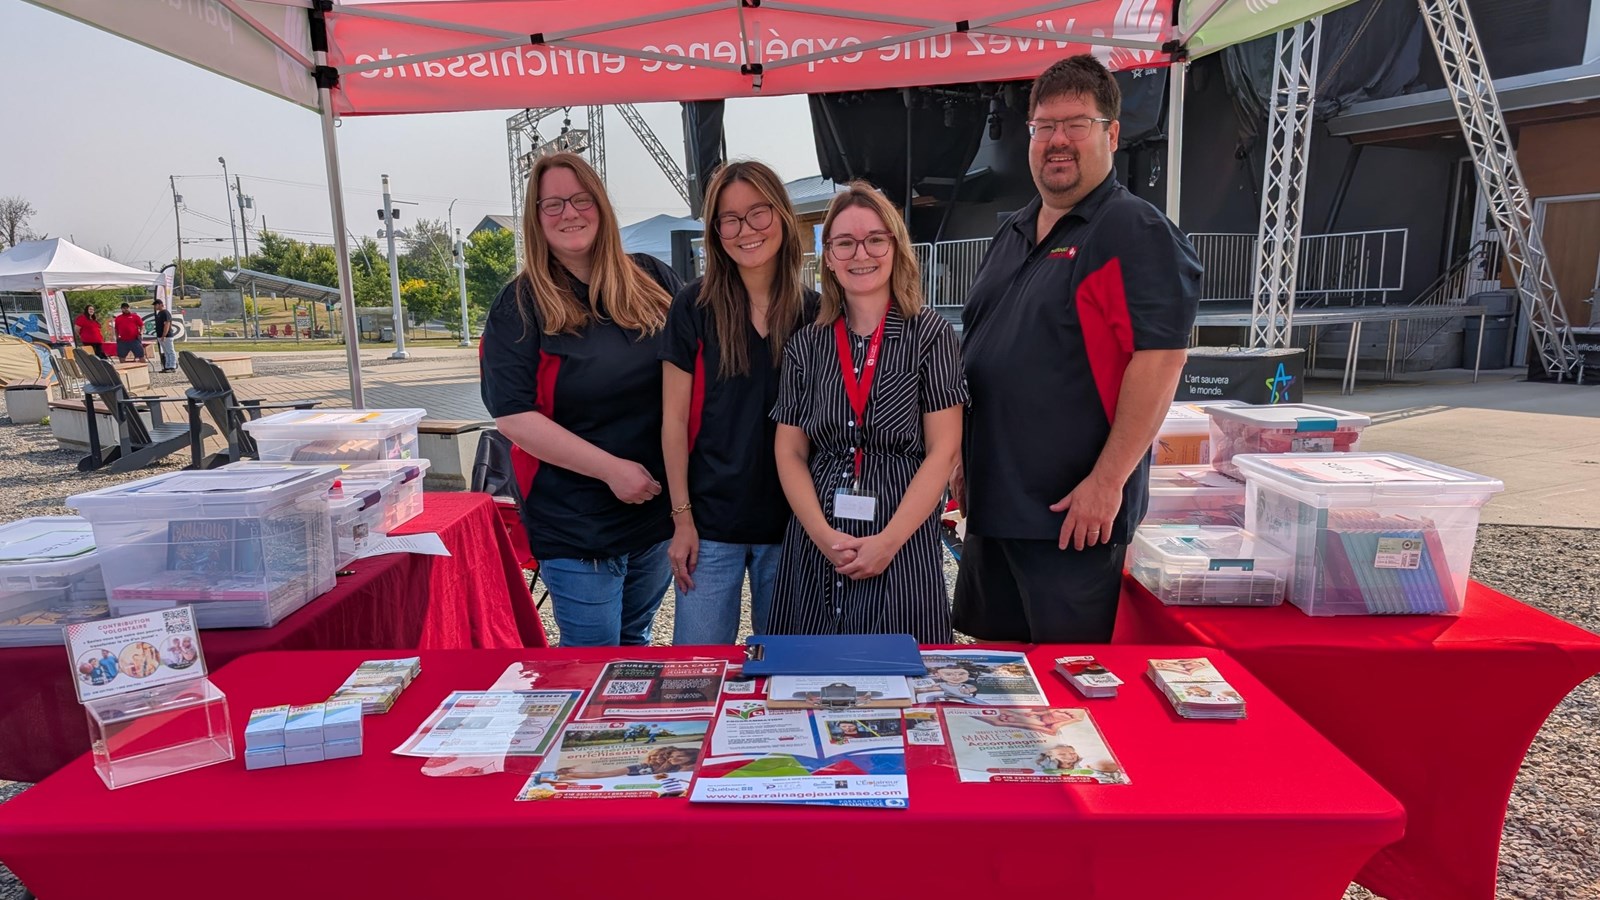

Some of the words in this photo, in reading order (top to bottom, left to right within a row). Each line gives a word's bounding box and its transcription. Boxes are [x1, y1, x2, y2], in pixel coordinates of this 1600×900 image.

[1185, 374, 1200, 383] L'art
[1201, 375, 1229, 384] sauvera
[1197, 387, 1223, 395] monde.
[97, 618, 151, 631] CONTRIBUTION
[103, 624, 147, 635] VOLONTAIRE
[968, 739, 1048, 747] Accompagner
[566, 749, 649, 760] enrichissante
[705, 790, 902, 799] www.parrainagejeunesse.com
